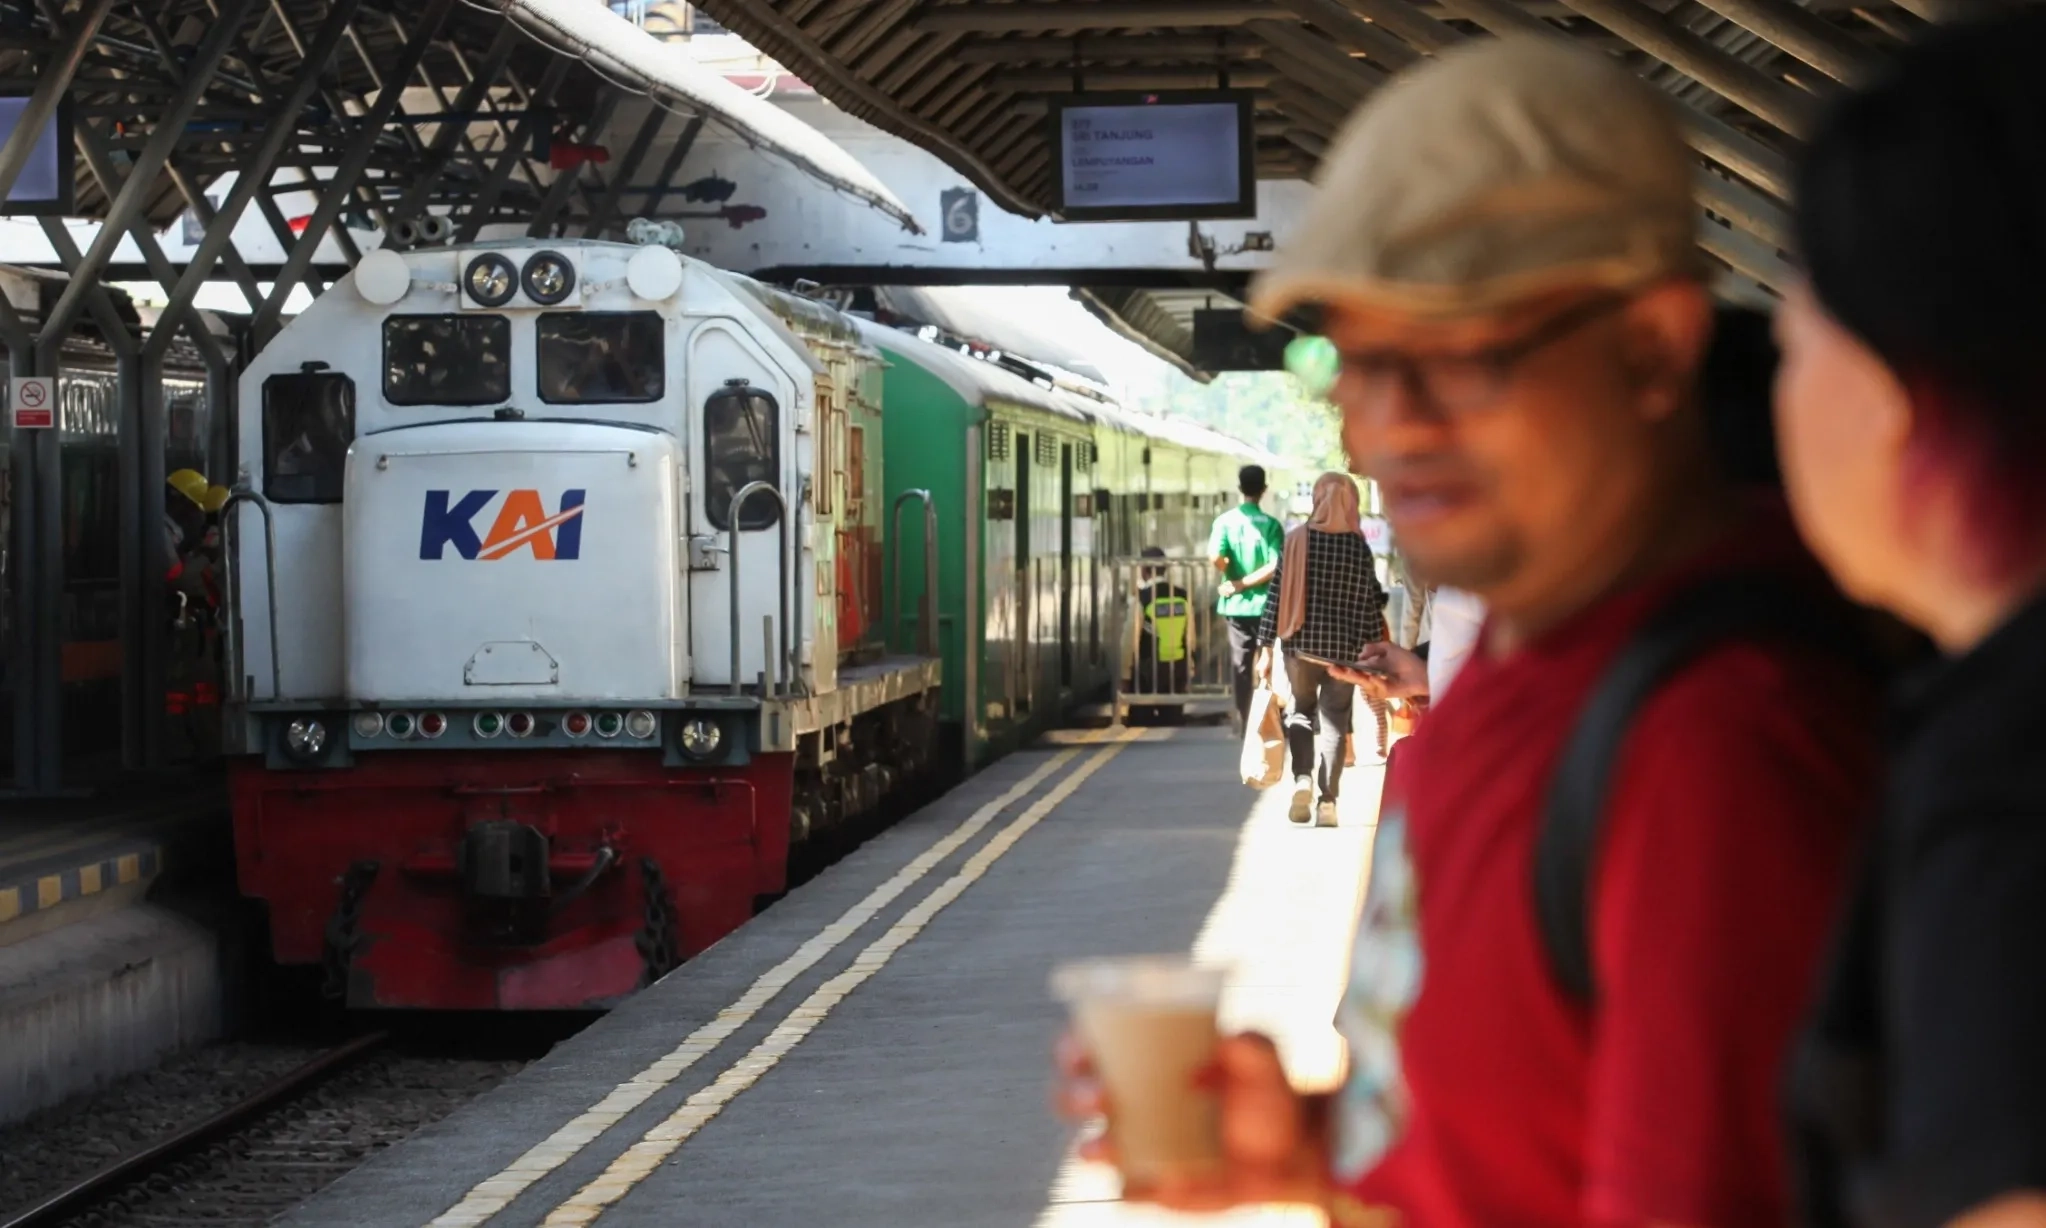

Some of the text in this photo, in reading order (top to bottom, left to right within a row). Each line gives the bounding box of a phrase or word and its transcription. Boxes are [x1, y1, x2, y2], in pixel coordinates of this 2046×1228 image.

[1094, 129, 1154, 141] TANJUNG
[947, 195, 972, 235] 6
[419, 489, 586, 560] KAI
